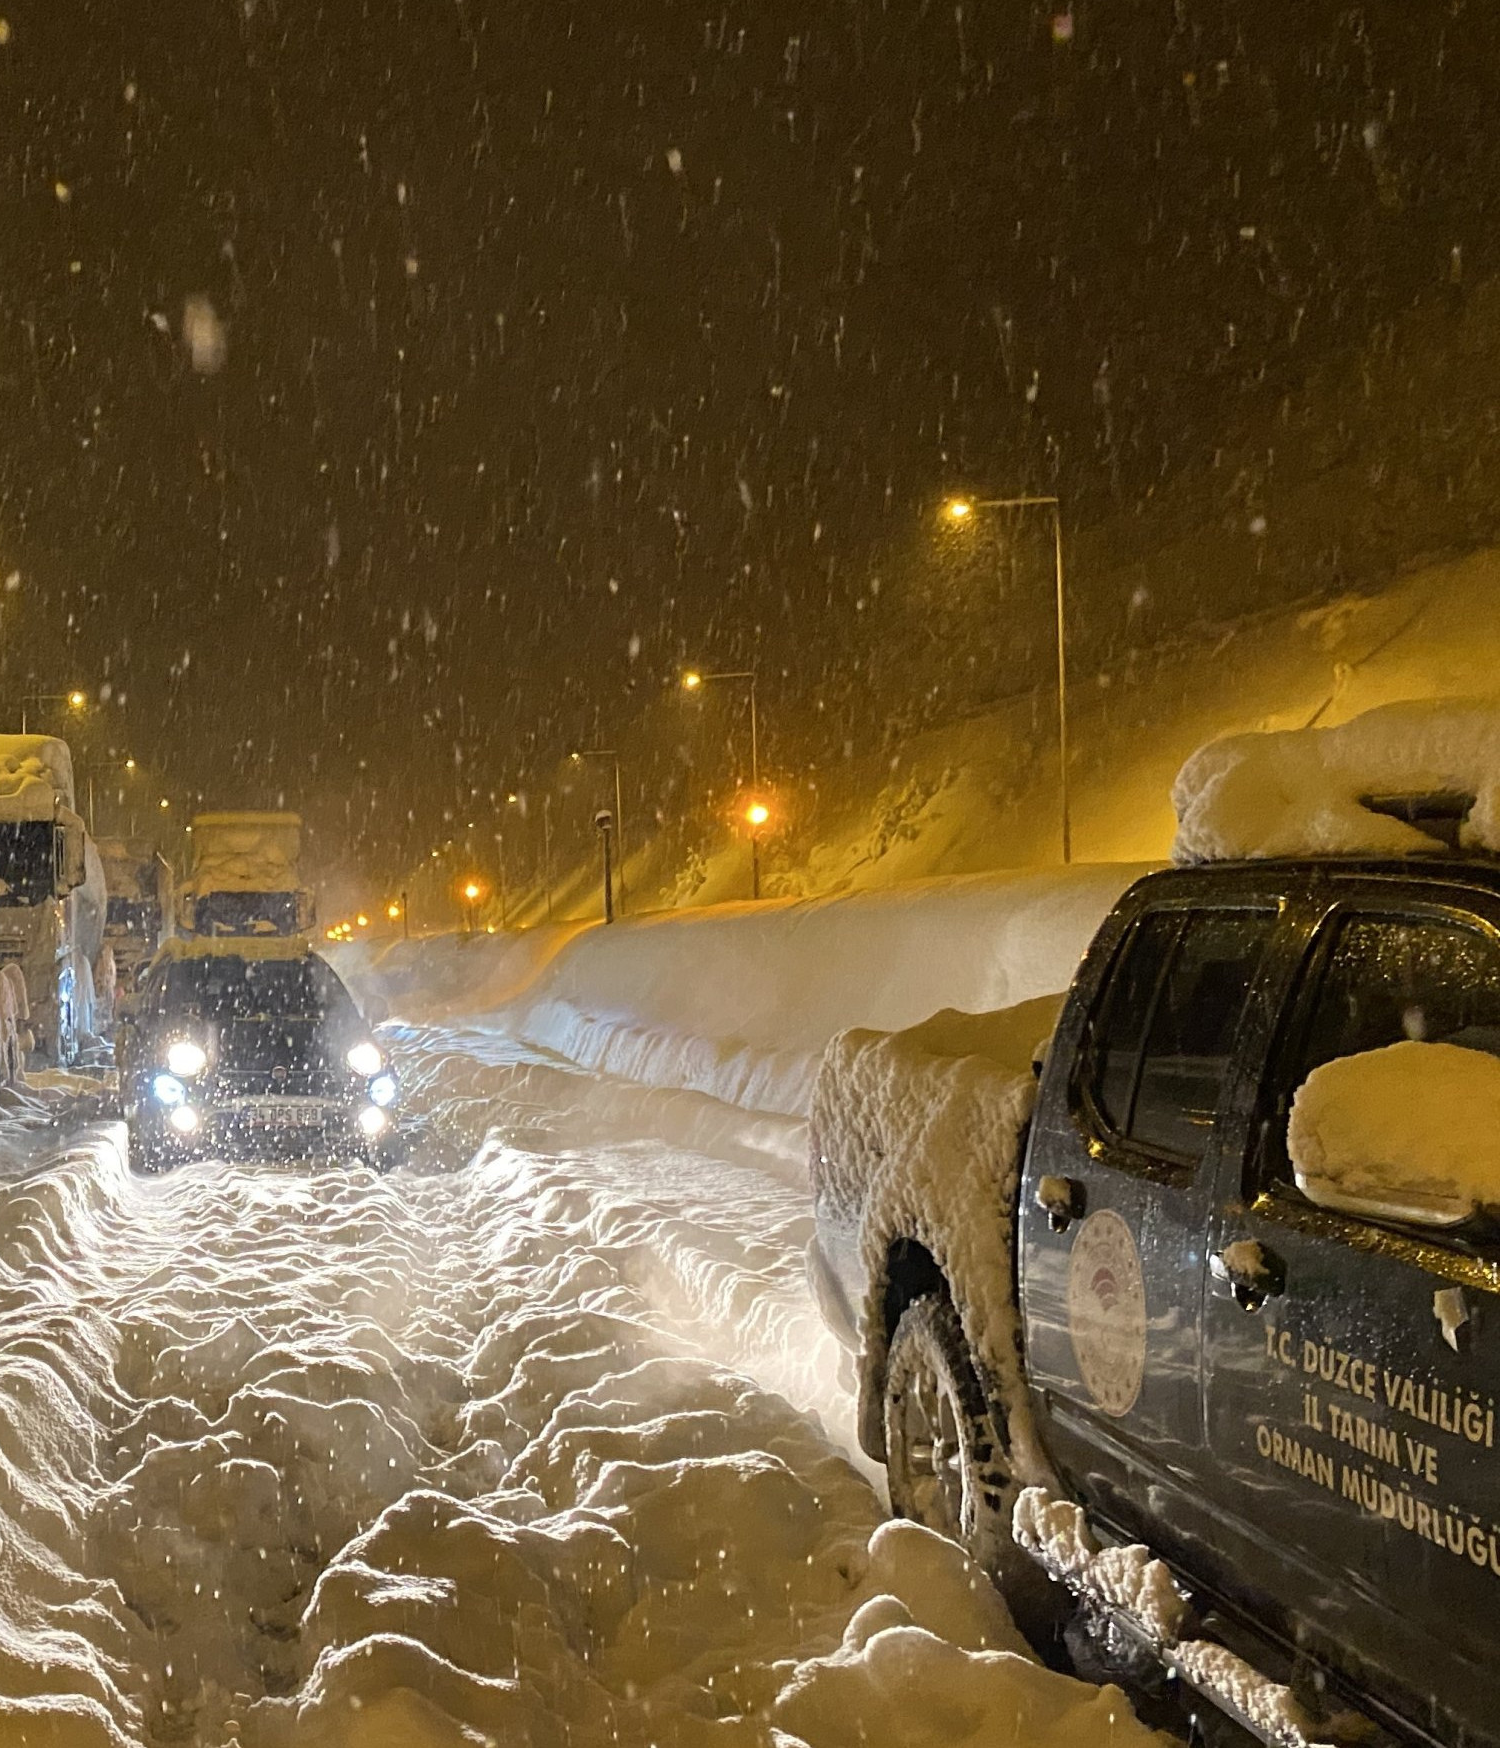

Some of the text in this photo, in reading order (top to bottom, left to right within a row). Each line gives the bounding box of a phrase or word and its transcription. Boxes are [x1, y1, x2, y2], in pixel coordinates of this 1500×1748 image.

[1265, 1325, 1494, 1447] T.C. DÜZCE VALİLİĞİ
[1303, 1384, 1438, 1485] İL TARIM VE
[1256, 1424, 1334, 1490] ORMAN
